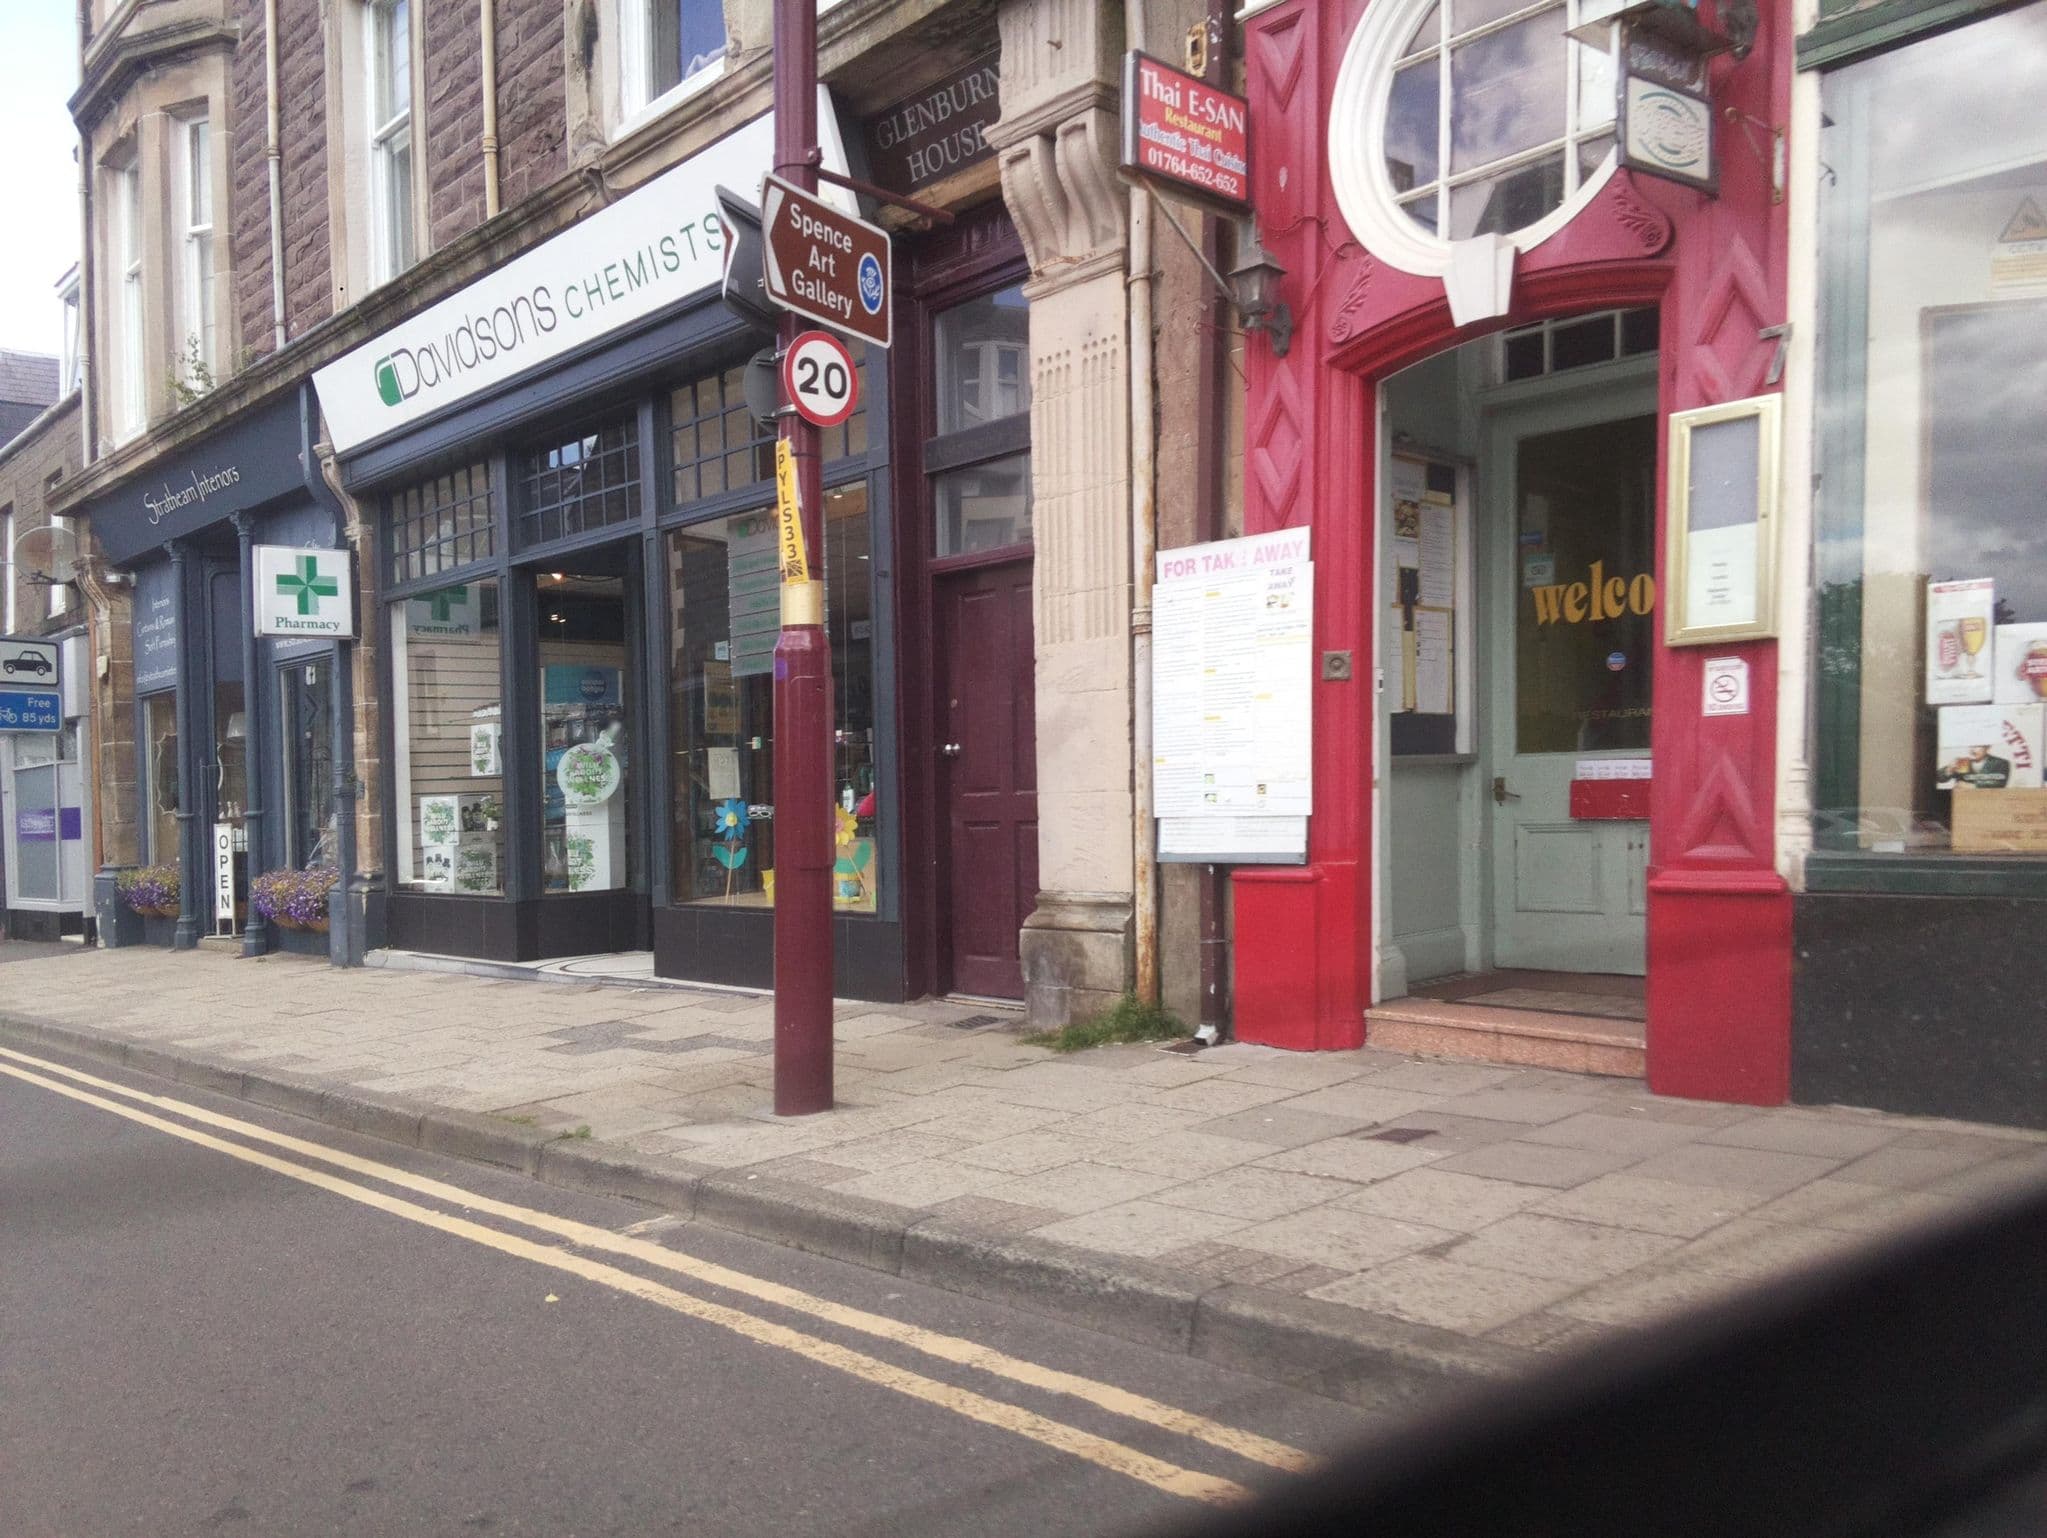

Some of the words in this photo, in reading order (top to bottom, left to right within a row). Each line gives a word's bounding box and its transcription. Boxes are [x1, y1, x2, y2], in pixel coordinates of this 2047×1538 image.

[877, 62, 1000, 150] GLENBURN
[1140, 68, 1181, 108] Thai
[1189, 89, 1244, 134] E-SAN
[1164, 107, 1223, 143] Restaurant
[906, 120, 990, 183] HOUSE
[1148, 147, 1238, 194] 01764-652-652
[1189, 138, 1211, 163] Thai
[790, 204, 853, 254] Spence
[808, 245, 836, 278] Art
[390, 285, 557, 401] Davidsons
[565, 212, 721, 318] CHEMISTS
[791, 272, 853, 319] Gallery
[797, 357, 847, 399] 20
[191, 464, 240, 502] Interiors
[1163, 558, 1197, 579] FOR
[1201, 547, 1248, 572] TAK
[1253, 540, 1305, 566] AWAY
[1532, 559, 1656, 626] welco
[275, 616, 340, 632] Pharmacy
[22, 712, 37, 723] 85
[38, 713, 56, 725] yds
[27, 697, 51, 708] Free
[219, 834, 230, 909] OPEN
